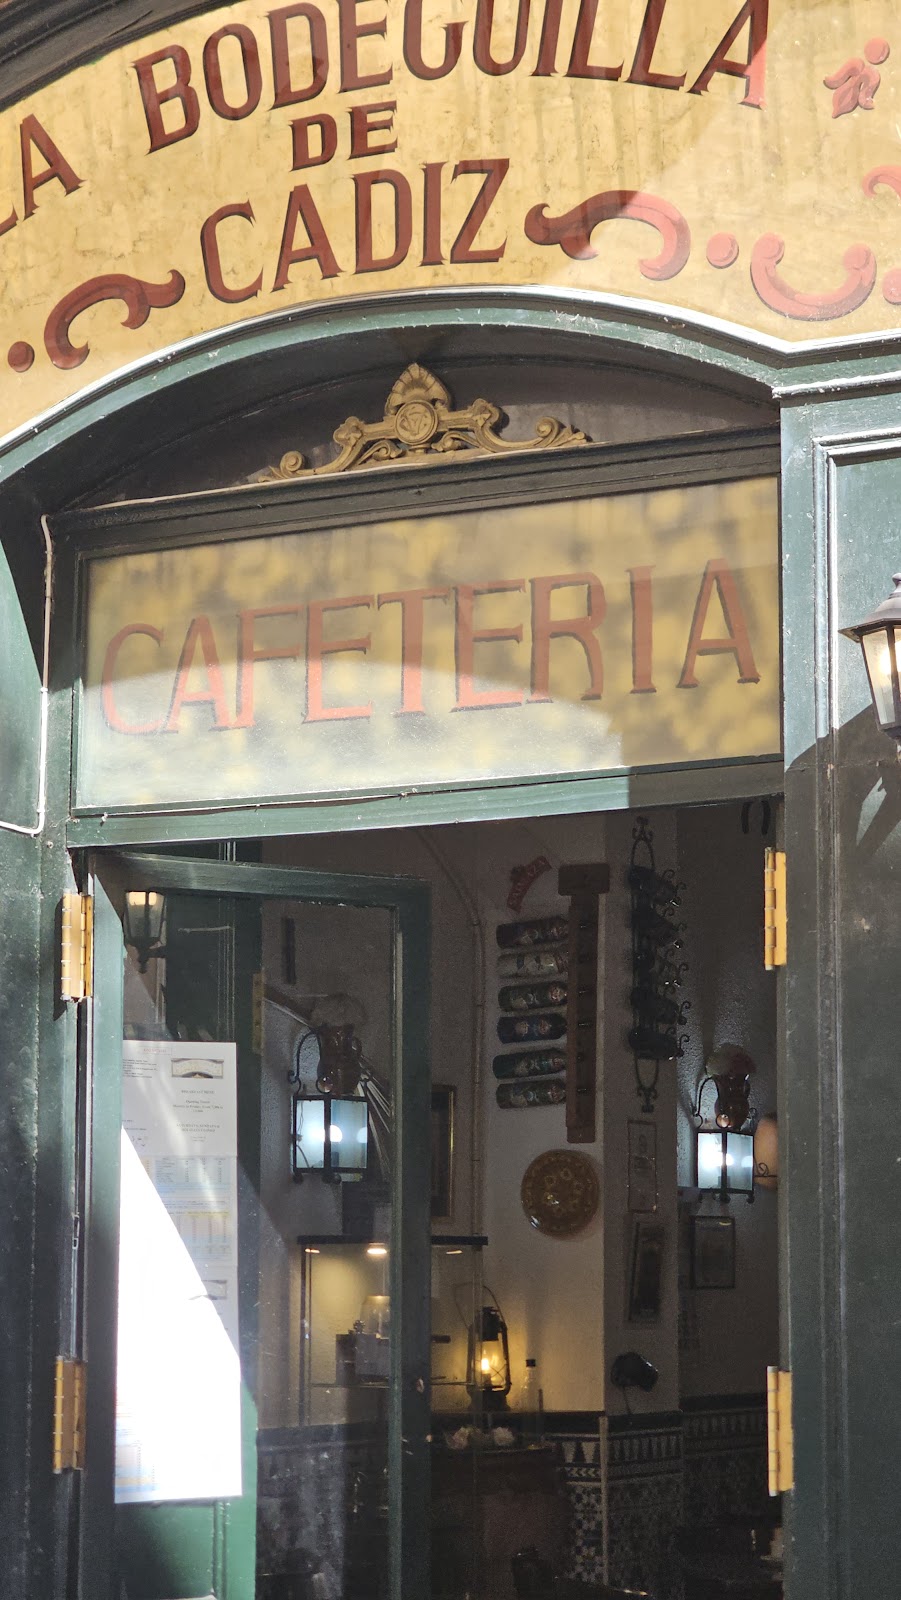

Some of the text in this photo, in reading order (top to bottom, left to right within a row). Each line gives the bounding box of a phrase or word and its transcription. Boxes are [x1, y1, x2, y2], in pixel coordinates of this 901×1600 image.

[0, 0, 768, 236] A BODEGUILLA
[290, 100, 398, 171] DE
[200, 158, 510, 304] CADIZ
[101, 558, 762, 735] CAFETERIA
